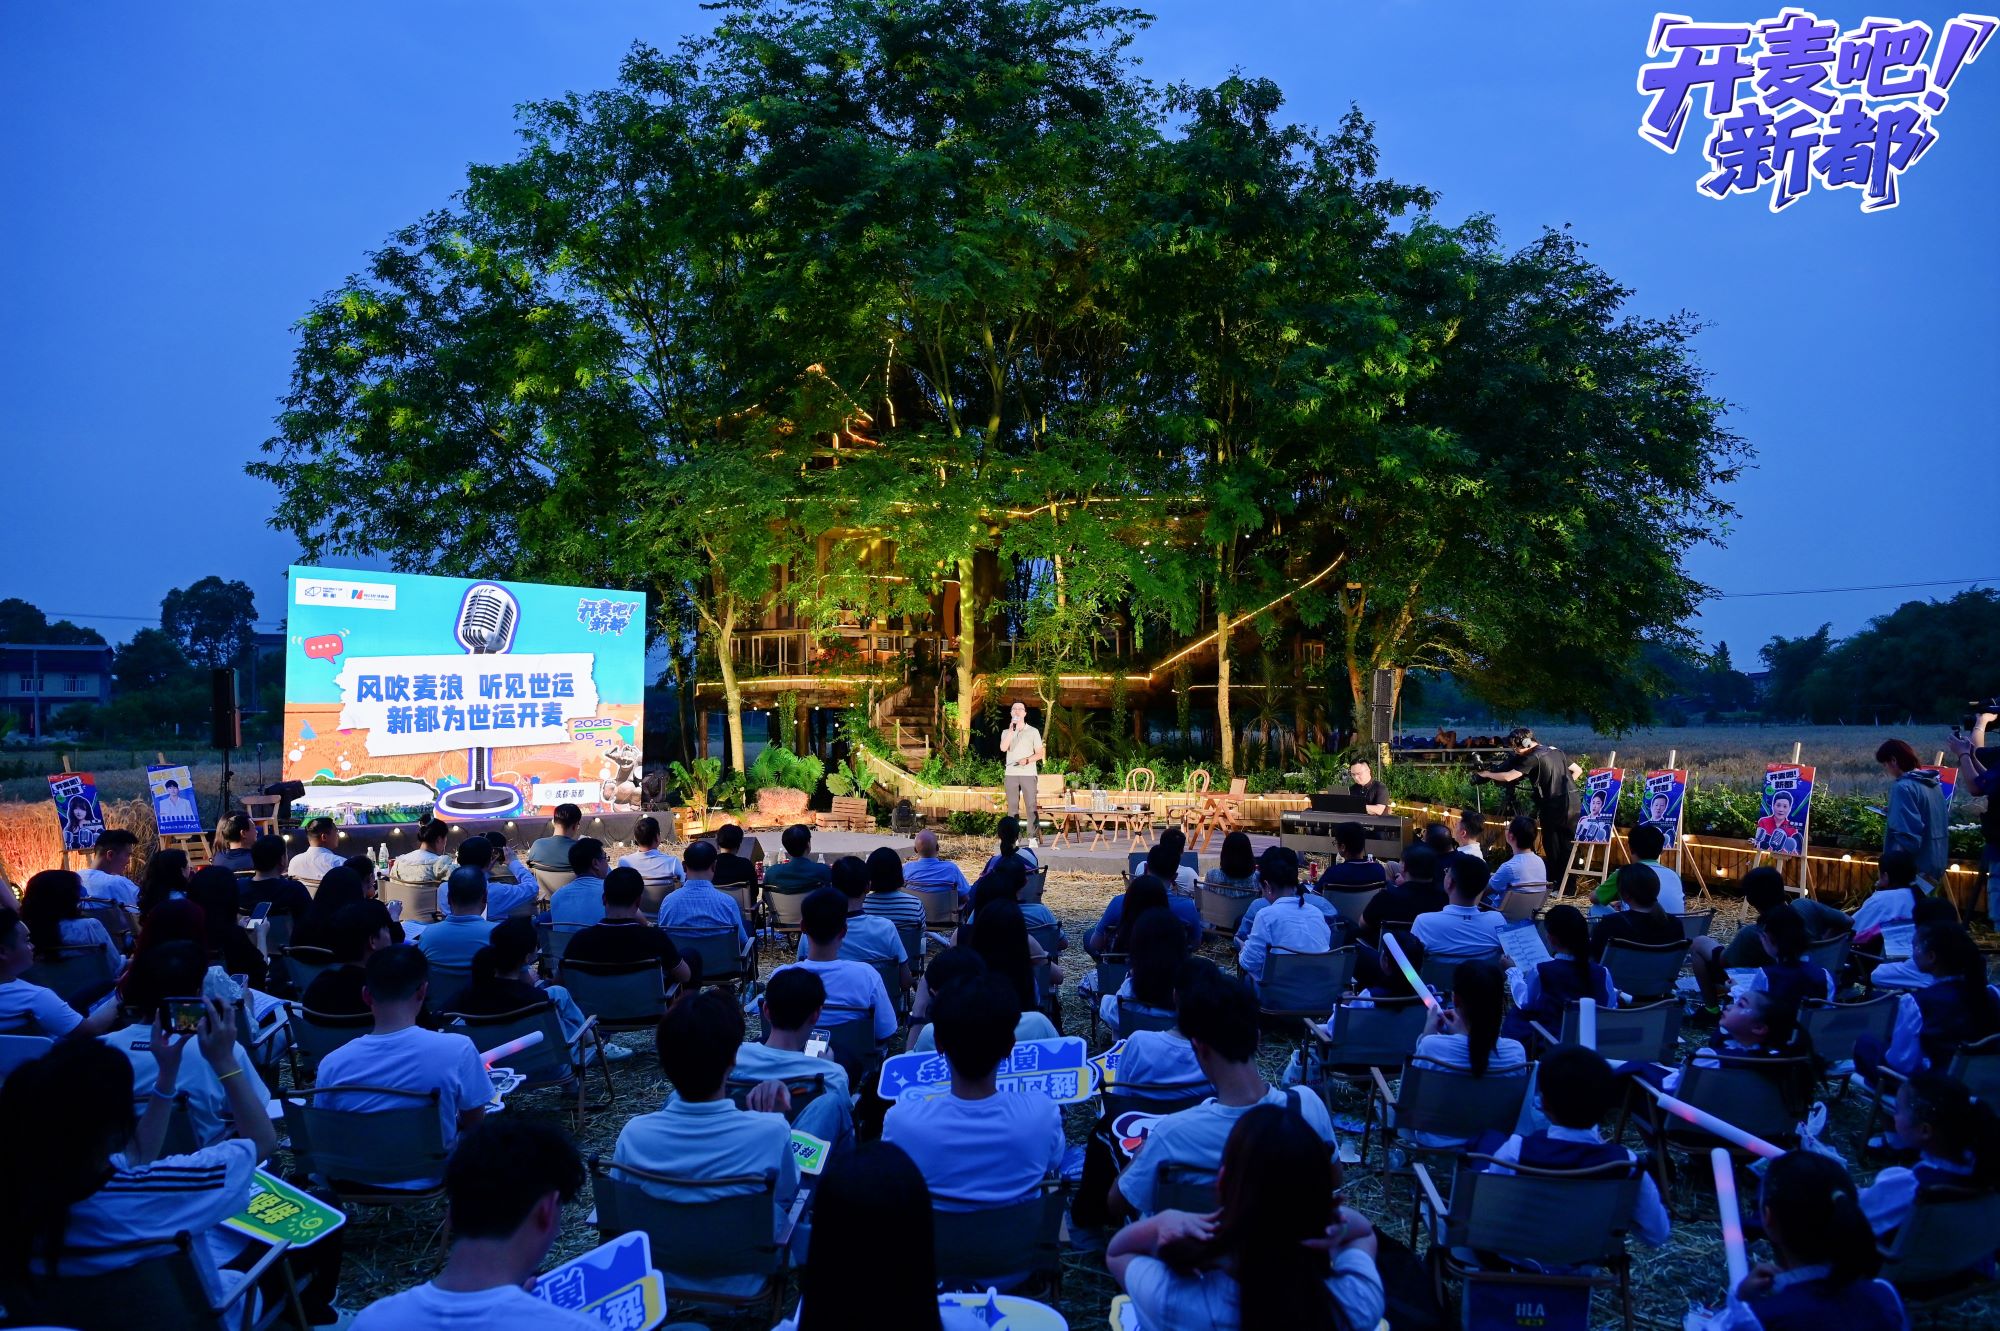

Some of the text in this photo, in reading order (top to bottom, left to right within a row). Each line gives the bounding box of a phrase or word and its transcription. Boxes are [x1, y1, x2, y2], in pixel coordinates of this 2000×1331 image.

[578, 599, 639, 622] 开麦吧!
[588, 615, 629, 635] 新都
[357, 672, 574, 702] 风吹麦浪 听见世运
[387, 702, 563, 734] 新都为世运开麦
[574, 719, 612, 728] 2025
[575, 732, 594, 740] 05
[1516, 1303, 1545, 1317] HLA
